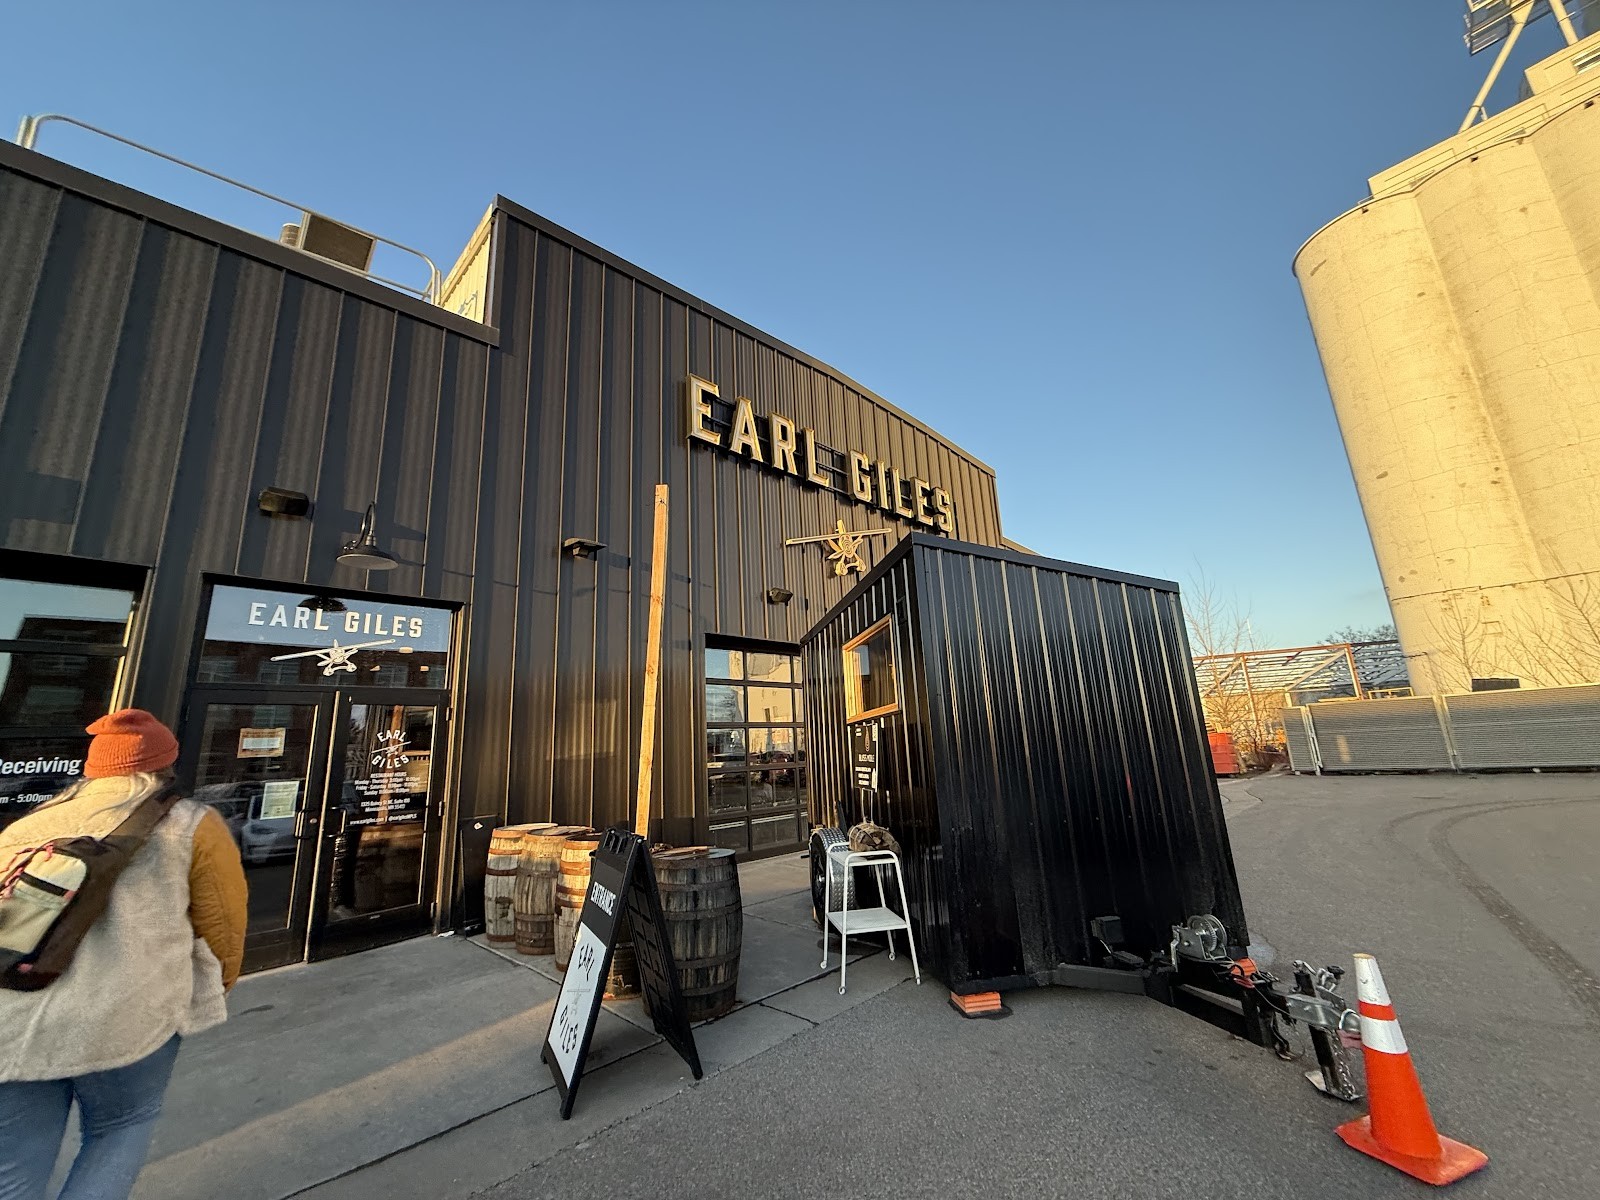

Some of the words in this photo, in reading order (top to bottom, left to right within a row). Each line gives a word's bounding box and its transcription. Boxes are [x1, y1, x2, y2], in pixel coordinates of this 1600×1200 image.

[686, 373, 829, 487] EARL
[850, 449, 954, 532] GILES
[248, 602, 329, 631] EARL
[344, 610, 423, 638] GILES
[376, 730, 406, 742] EARL
[371, 755, 409, 768] GILES
[590, 881, 617, 917] ENTRANCE
[578, 943, 595, 982] EARL
[559, 1004, 579, 1054] GILES
